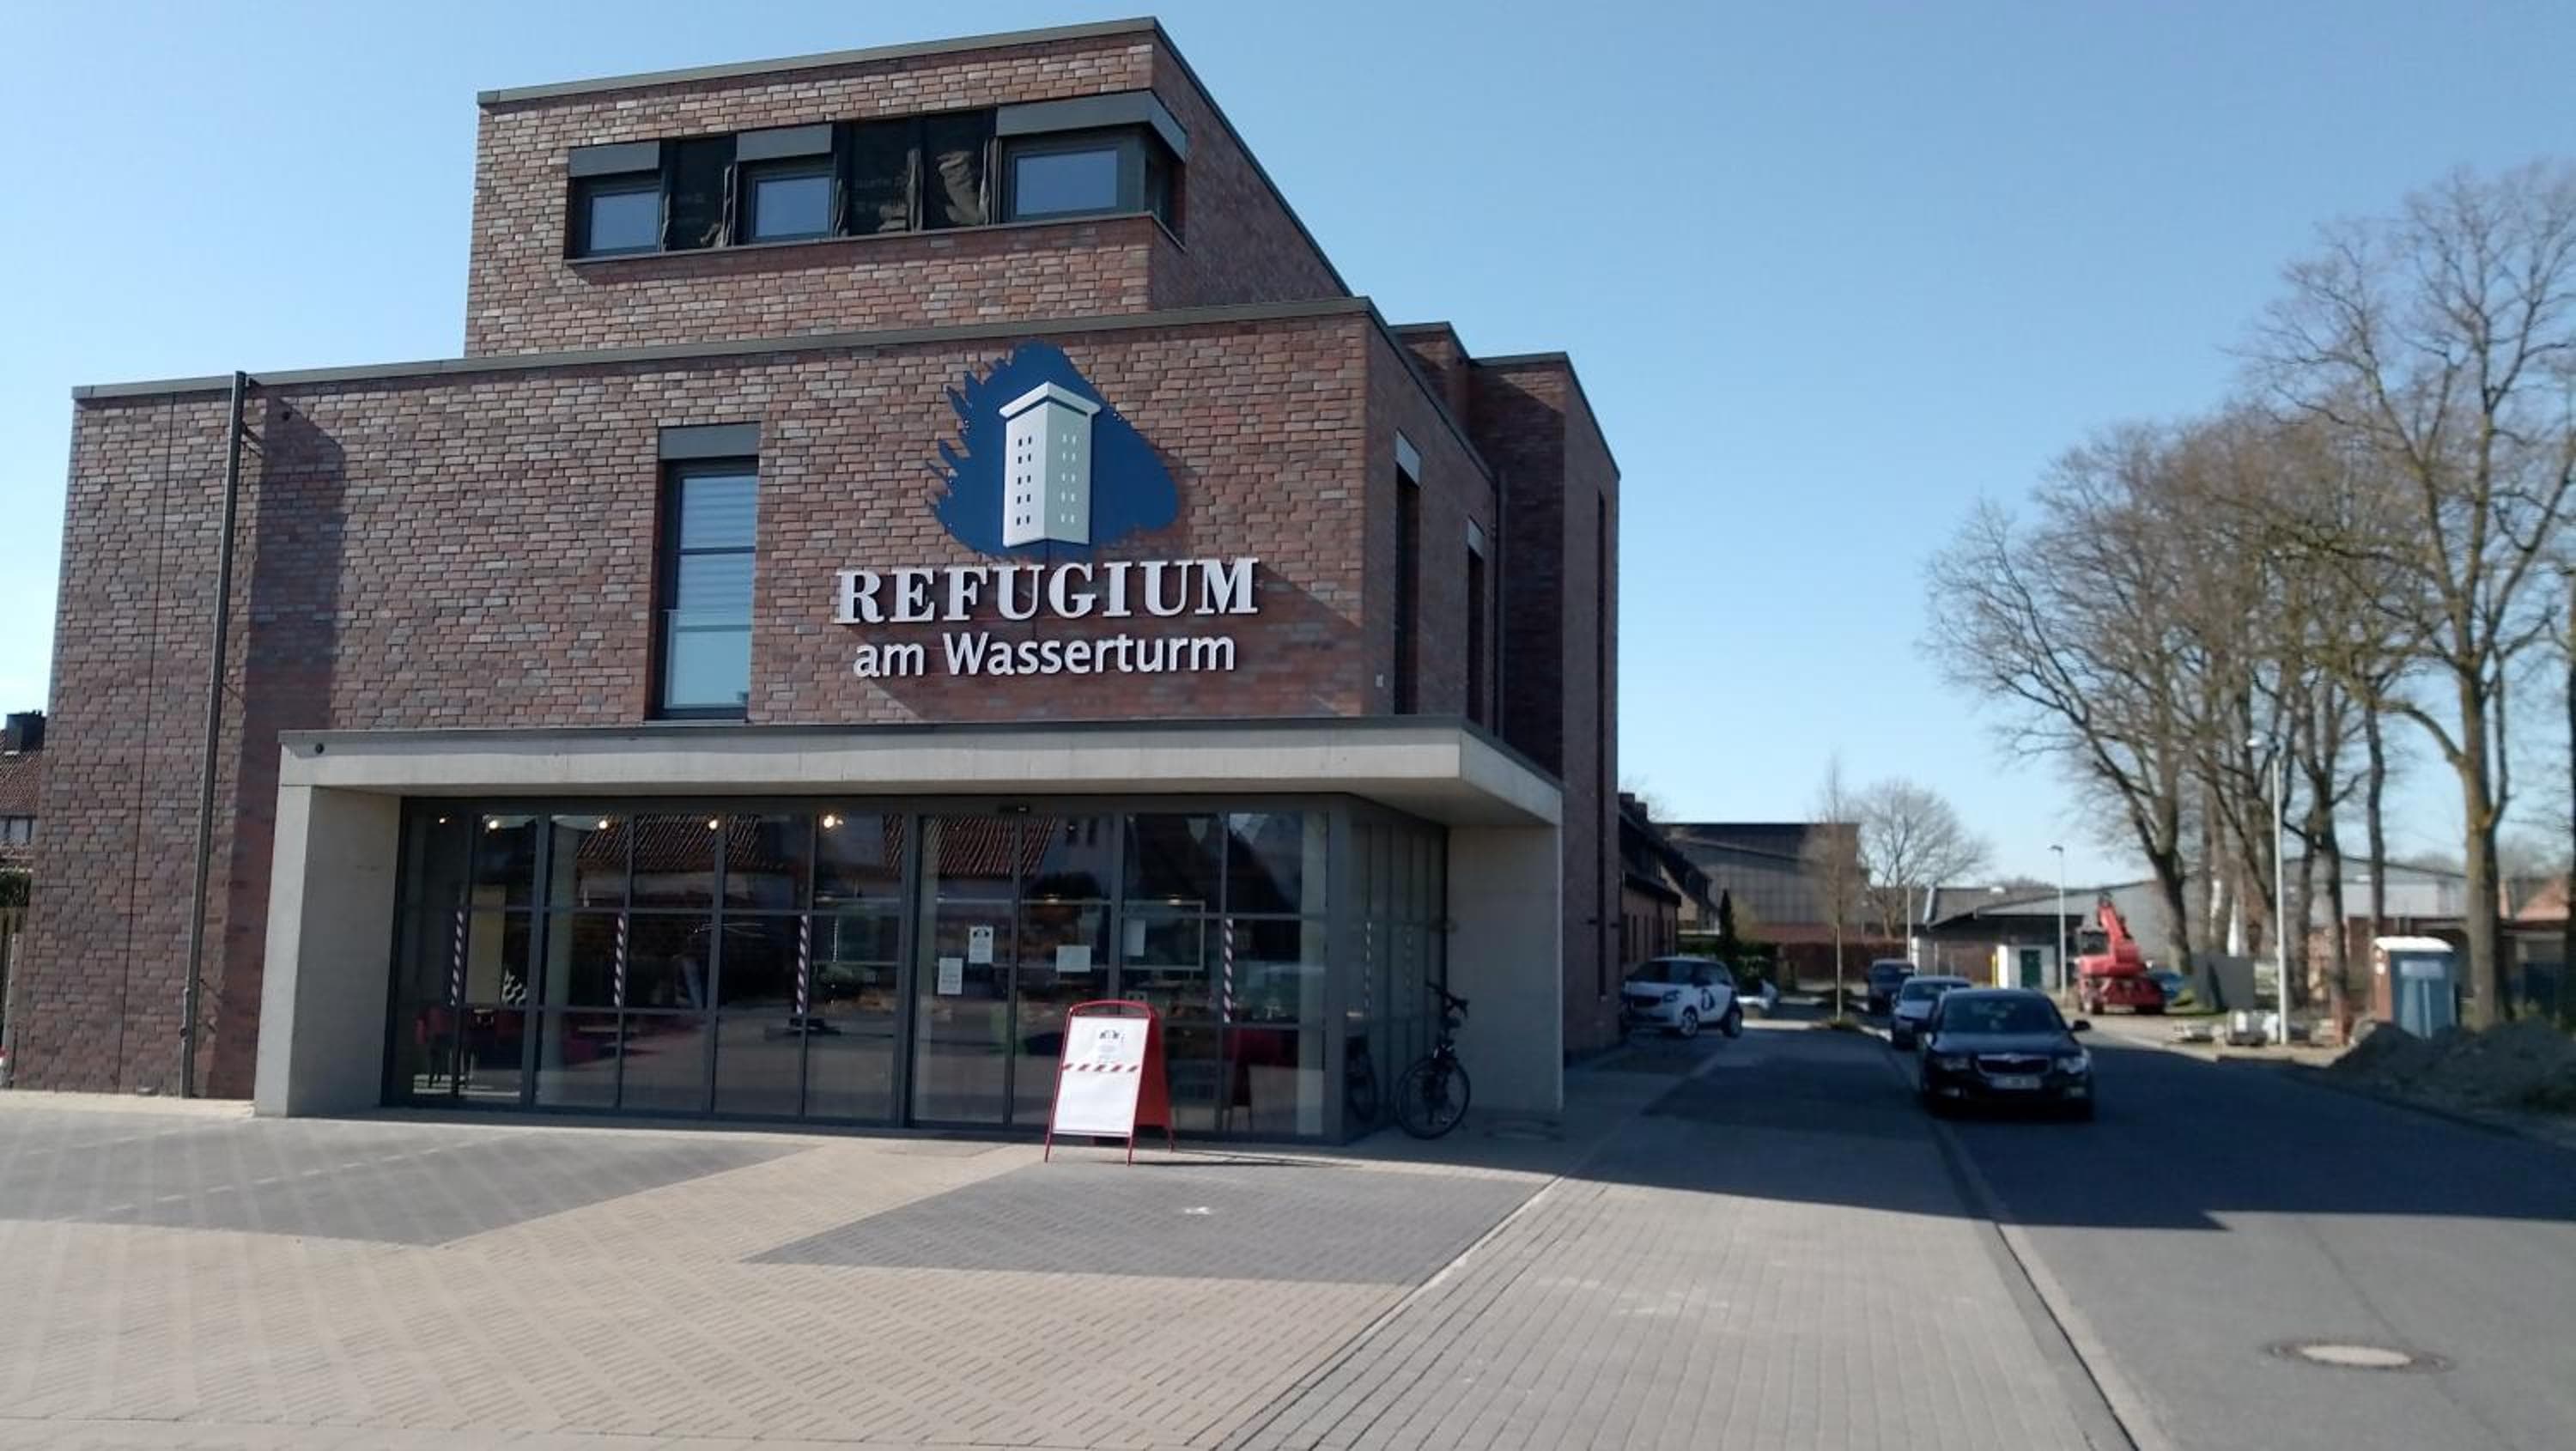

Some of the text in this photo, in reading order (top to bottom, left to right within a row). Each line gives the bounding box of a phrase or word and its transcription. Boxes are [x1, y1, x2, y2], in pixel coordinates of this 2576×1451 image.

[835, 557, 1260, 624] REFUGIUM
[853, 630, 1236, 677] am Wasserturm
